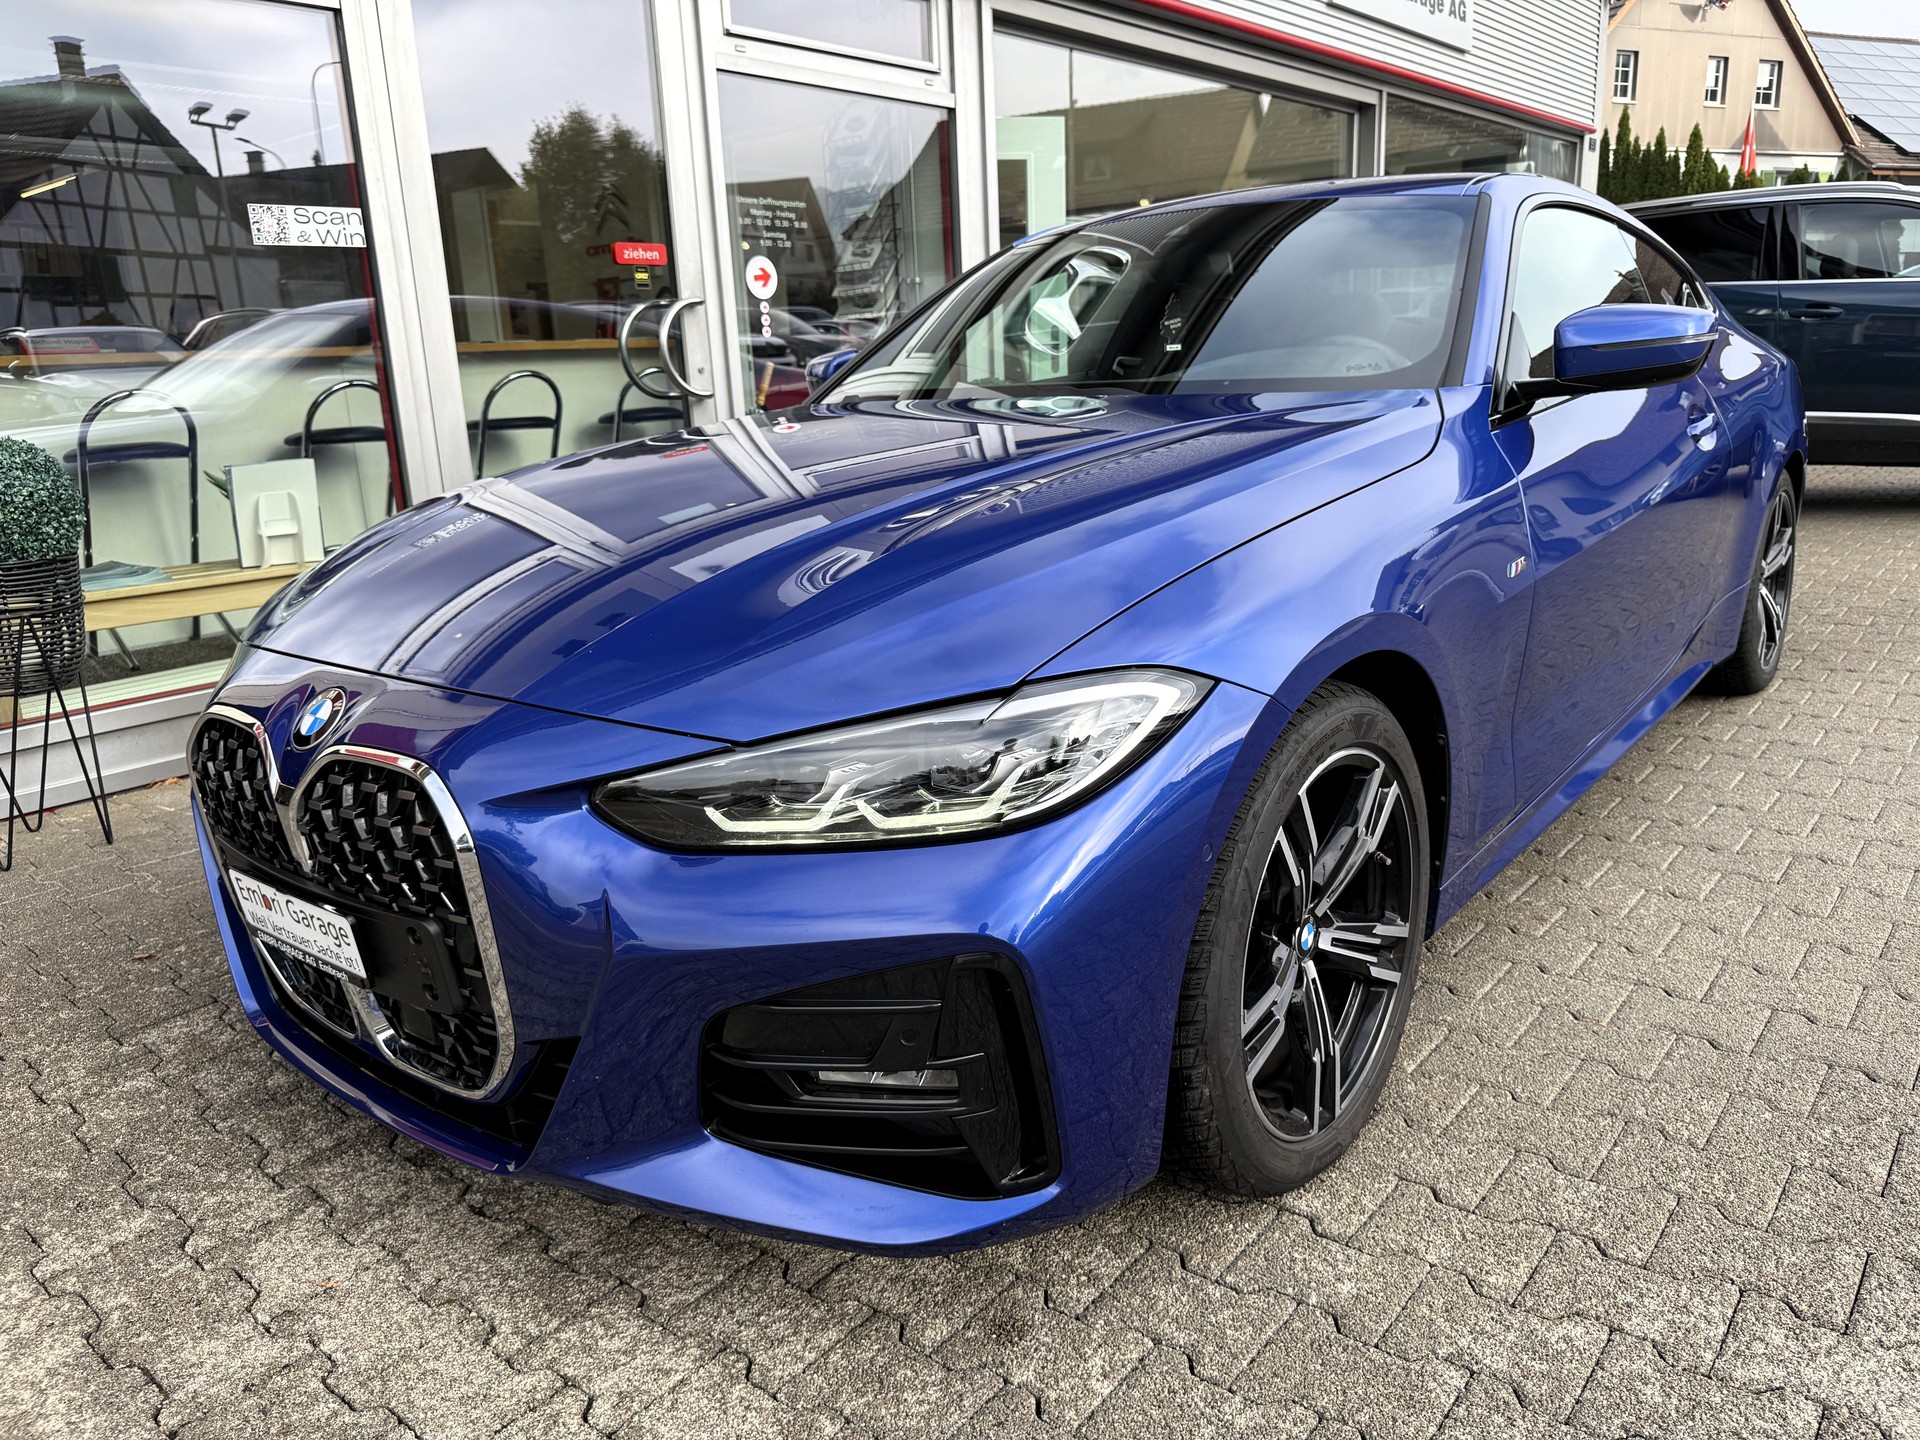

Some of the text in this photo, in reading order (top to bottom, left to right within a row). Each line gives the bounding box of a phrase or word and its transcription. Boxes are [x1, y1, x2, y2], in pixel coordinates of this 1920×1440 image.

[1448, 0, 1467, 22] AG
[735, 196, 758, 204] Unsere
[293, 207, 363, 226] Scan
[749, 208, 773, 218] Montag
[776, 210, 796, 220] Freitag
[297, 227, 365, 246] & Win
[762, 231, 787, 240] Samstag
[623, 247, 660, 260] ziehen
[235, 877, 351, 948] Embri Garage
[248, 909, 269, 929] Weil
[268, 918, 314, 954] Vertrauen
[314, 940, 343, 964] Sache
[305, 954, 317, 967] AG
[319, 961, 349, 981] Embrach
